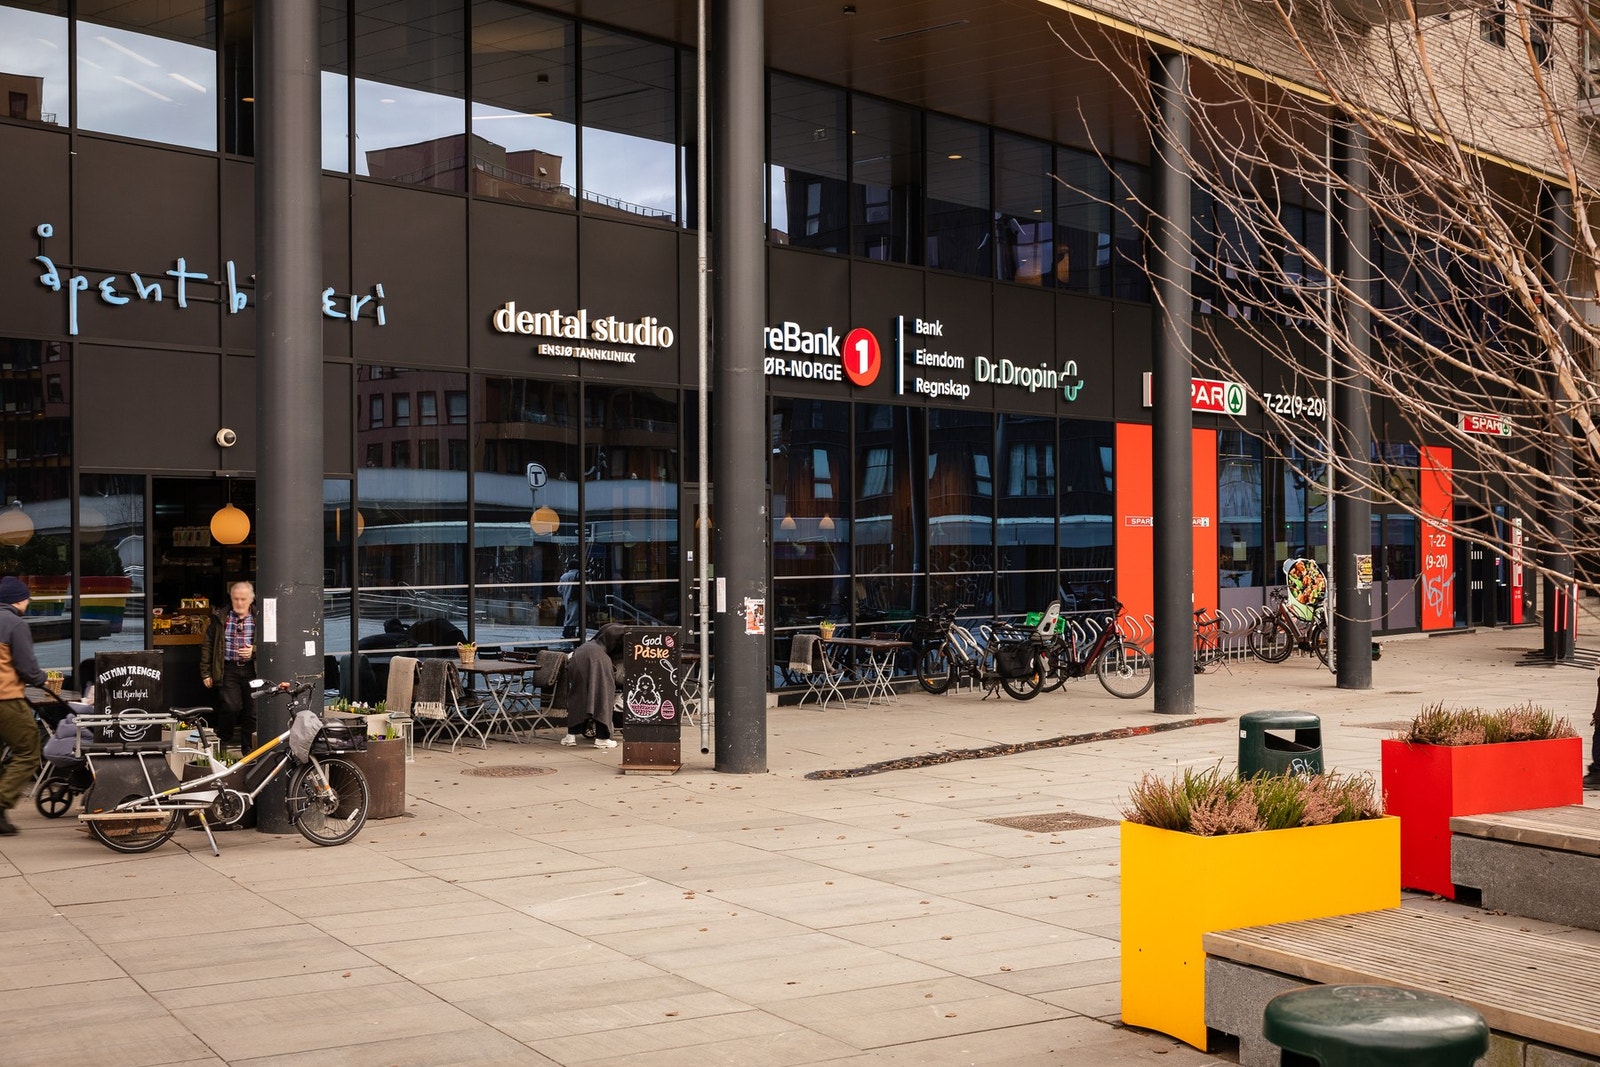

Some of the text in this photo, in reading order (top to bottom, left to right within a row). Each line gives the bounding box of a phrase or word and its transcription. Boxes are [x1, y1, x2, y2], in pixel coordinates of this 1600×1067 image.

[226, 260, 385, 326] beri
[494, 301, 674, 348] dental studio
[914, 318, 943, 337] Bank
[538, 343, 637, 363] ENSJØ TANNKLINIKK
[764, 321, 869, 375] reBank 1
[914, 348, 965, 369] Eiendom
[764, 357, 842, 381] ØR-NORGE
[975, 355, 1058, 393] Dr.Dropin
[914, 377, 971, 400] Regnskap
[1191, 385, 1224, 407] AR
[1131, 518, 1151, 526] SPAR
[1192, 518, 1202, 526] AR
[1426, 553, 1448, 570] (9-20)
[641, 634, 663, 646] God
[634, 644, 670, 661] Påske
[99, 665, 161, 684] ALT MAN TRENGER
